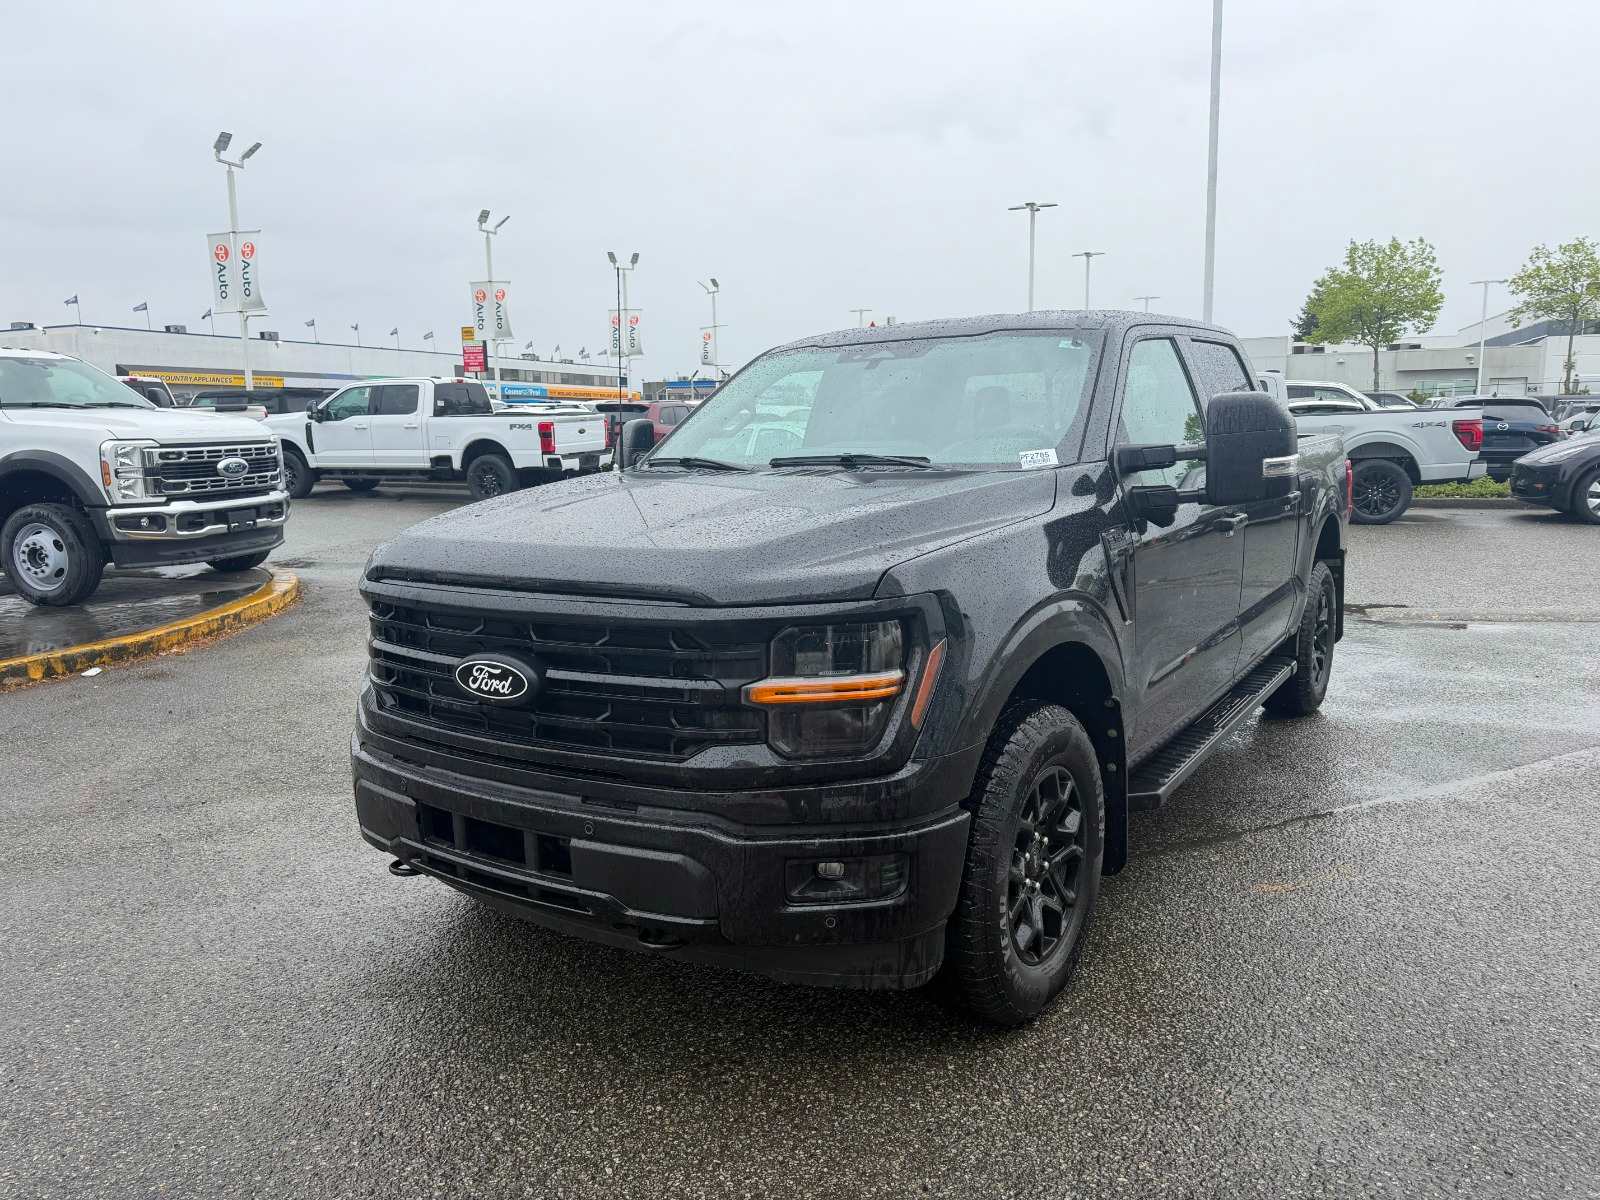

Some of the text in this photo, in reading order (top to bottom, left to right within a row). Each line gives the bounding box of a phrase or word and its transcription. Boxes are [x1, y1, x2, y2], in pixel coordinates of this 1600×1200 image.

[216, 262, 229, 300] Auto
[241, 259, 252, 298] Auto
[475, 302, 485, 330] Auto
[495, 301, 503, 330] Auto
[192, 376, 233, 384] APPLIANCES
[469, 664, 513, 694] Ford
